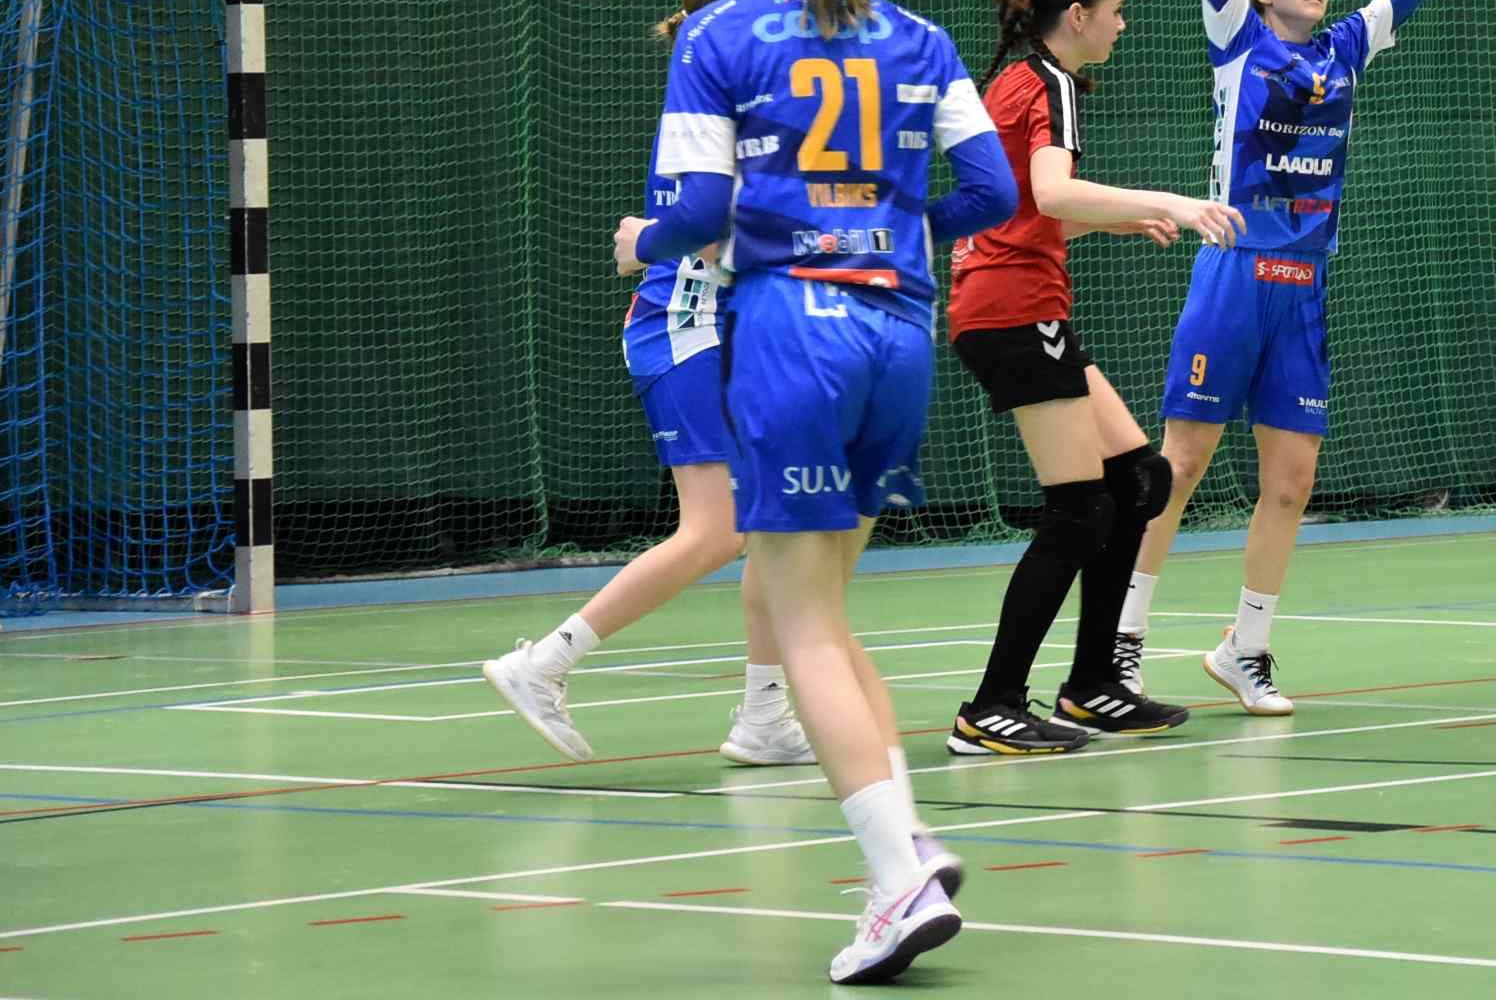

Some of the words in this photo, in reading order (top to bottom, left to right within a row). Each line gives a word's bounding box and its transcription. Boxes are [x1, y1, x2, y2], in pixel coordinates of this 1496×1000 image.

[790, 57, 883, 172] 21
[1258, 118, 1327, 137] HORIZON
[1189, 353, 1208, 387] 9
